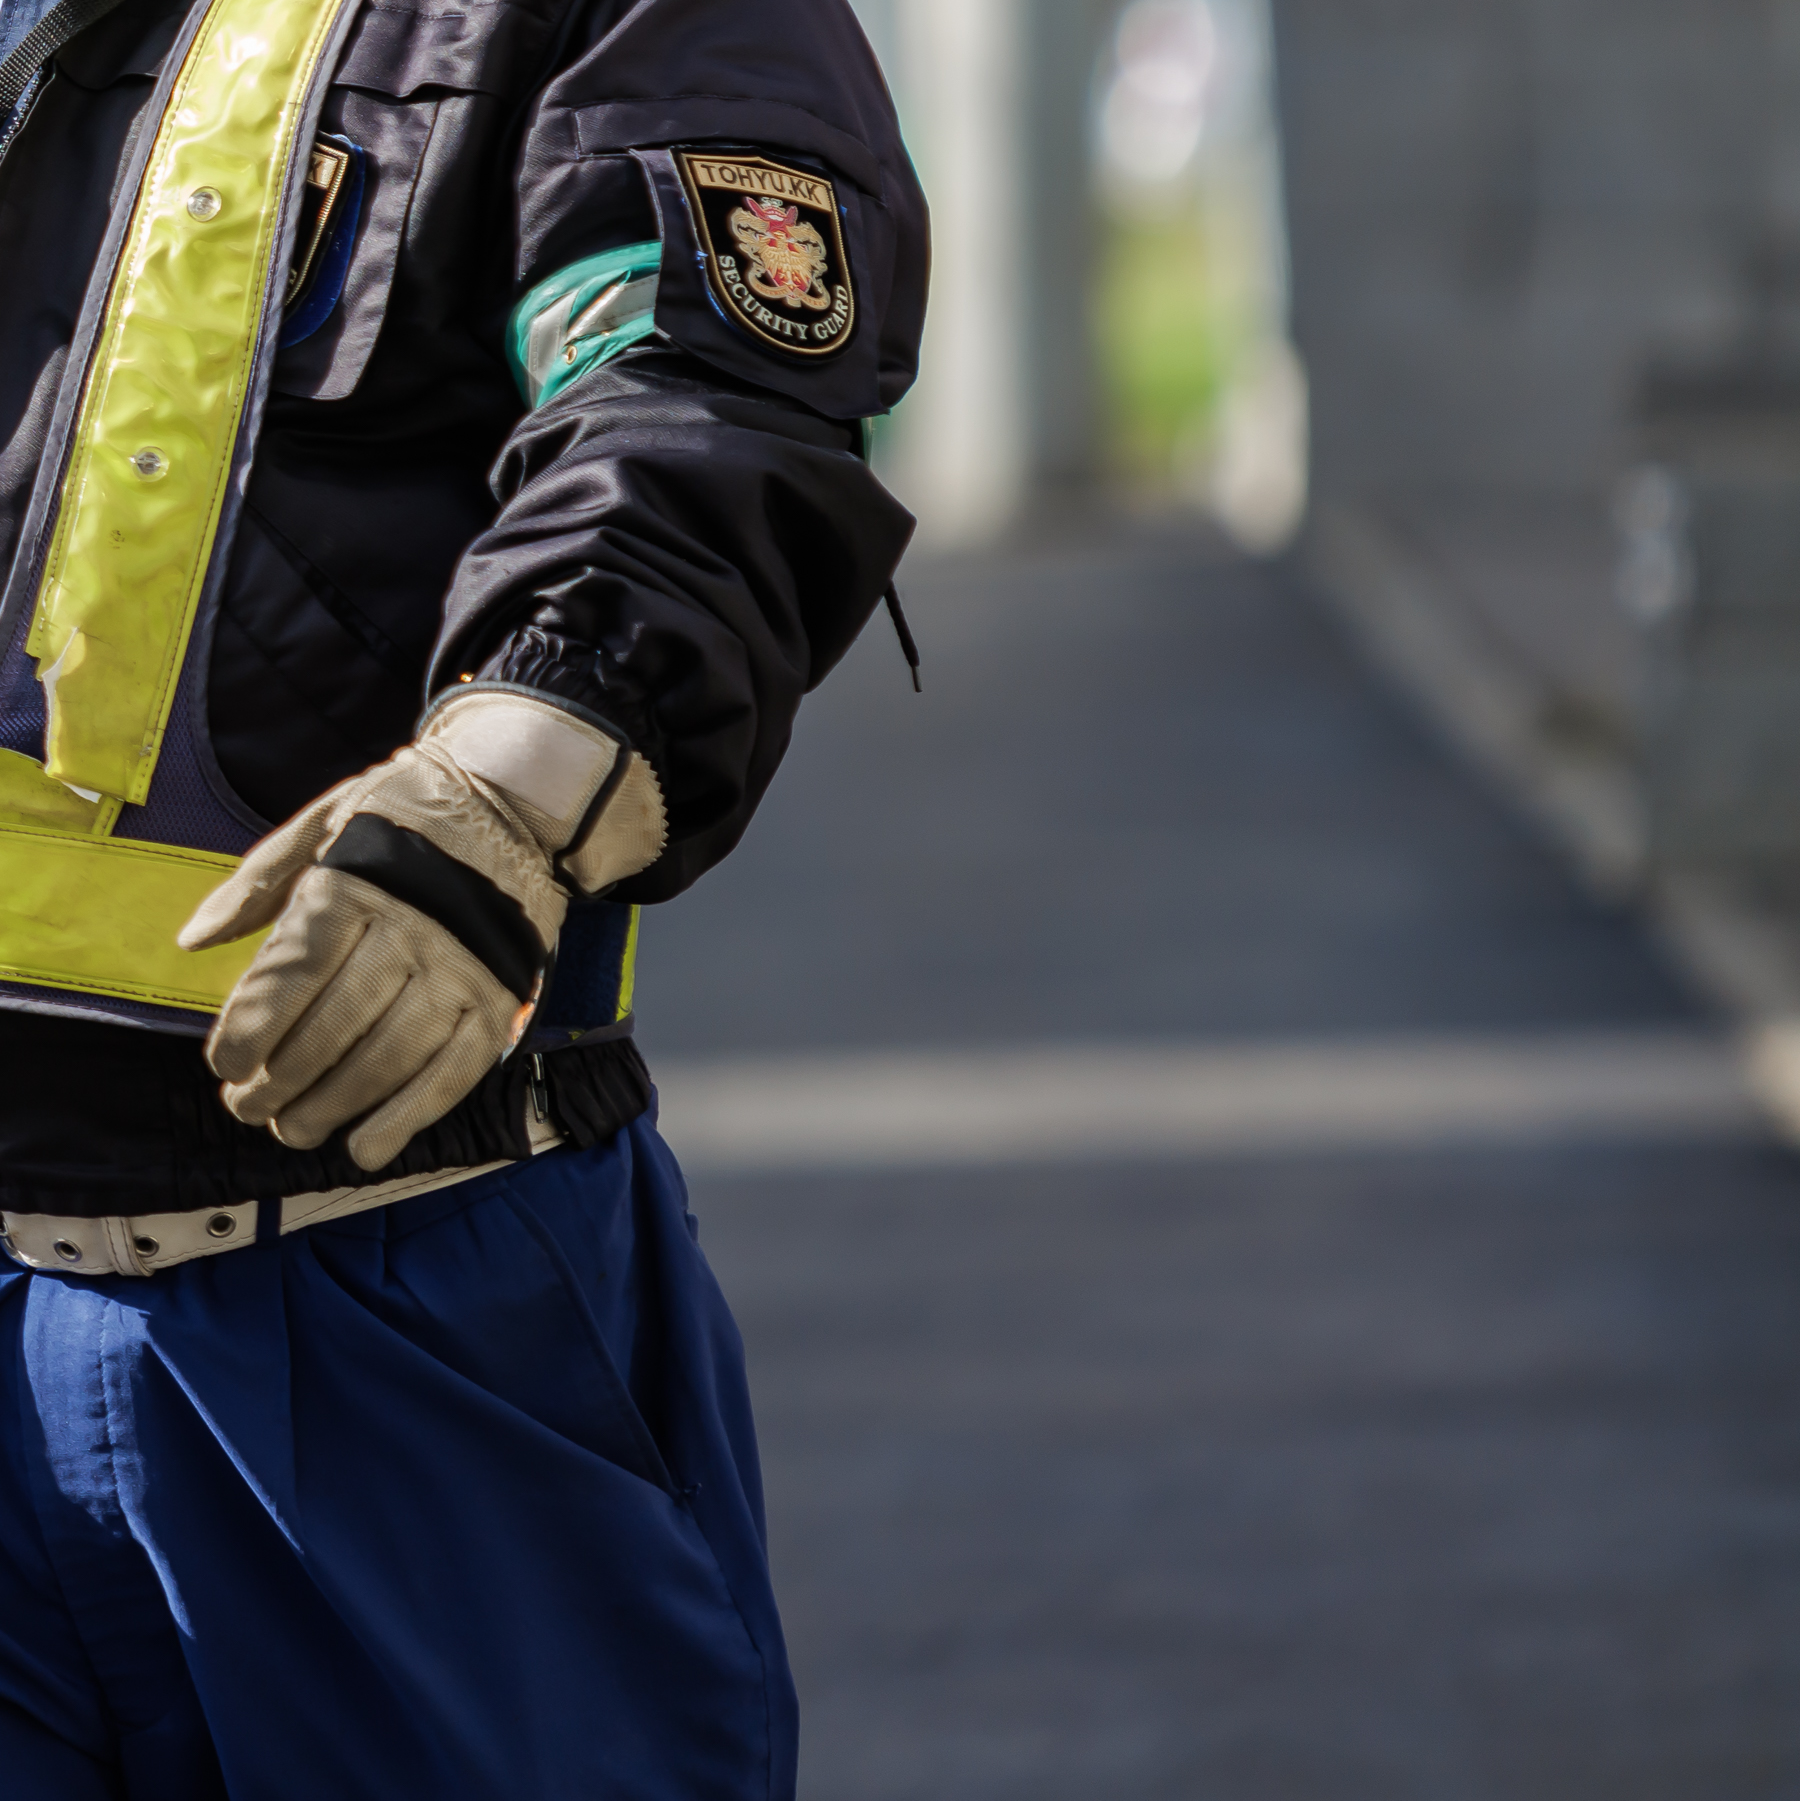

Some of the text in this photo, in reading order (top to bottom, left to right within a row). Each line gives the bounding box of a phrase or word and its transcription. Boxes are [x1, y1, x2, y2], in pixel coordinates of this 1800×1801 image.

[700, 163, 822, 205] TOHYU.KK
[719, 255, 849, 340] SECURITY GUARD
